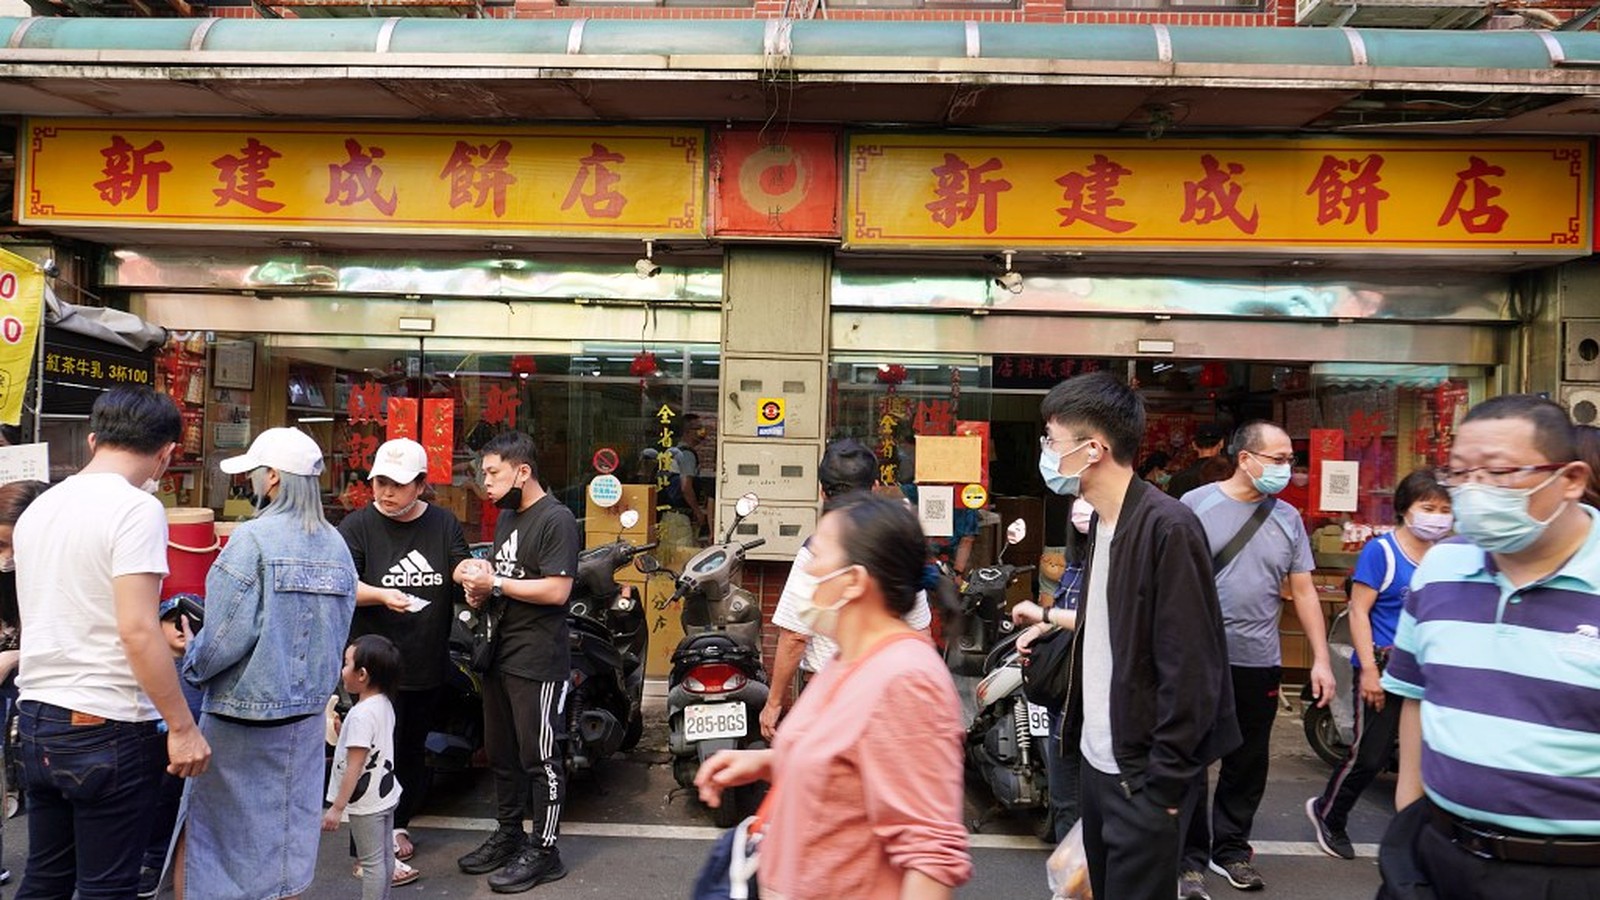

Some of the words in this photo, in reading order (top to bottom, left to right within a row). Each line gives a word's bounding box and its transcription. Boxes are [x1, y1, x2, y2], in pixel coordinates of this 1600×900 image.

[92, 134, 630, 219] 新建成餅店
[924, 153, 1510, 235] 新建成餅店
[45, 353, 104, 379] 紅茶牛乳
[108, 365, 148, 384] 3杯100
[381, 571, 444, 587] adidas
[687, 714, 745, 735] 285-BGS
